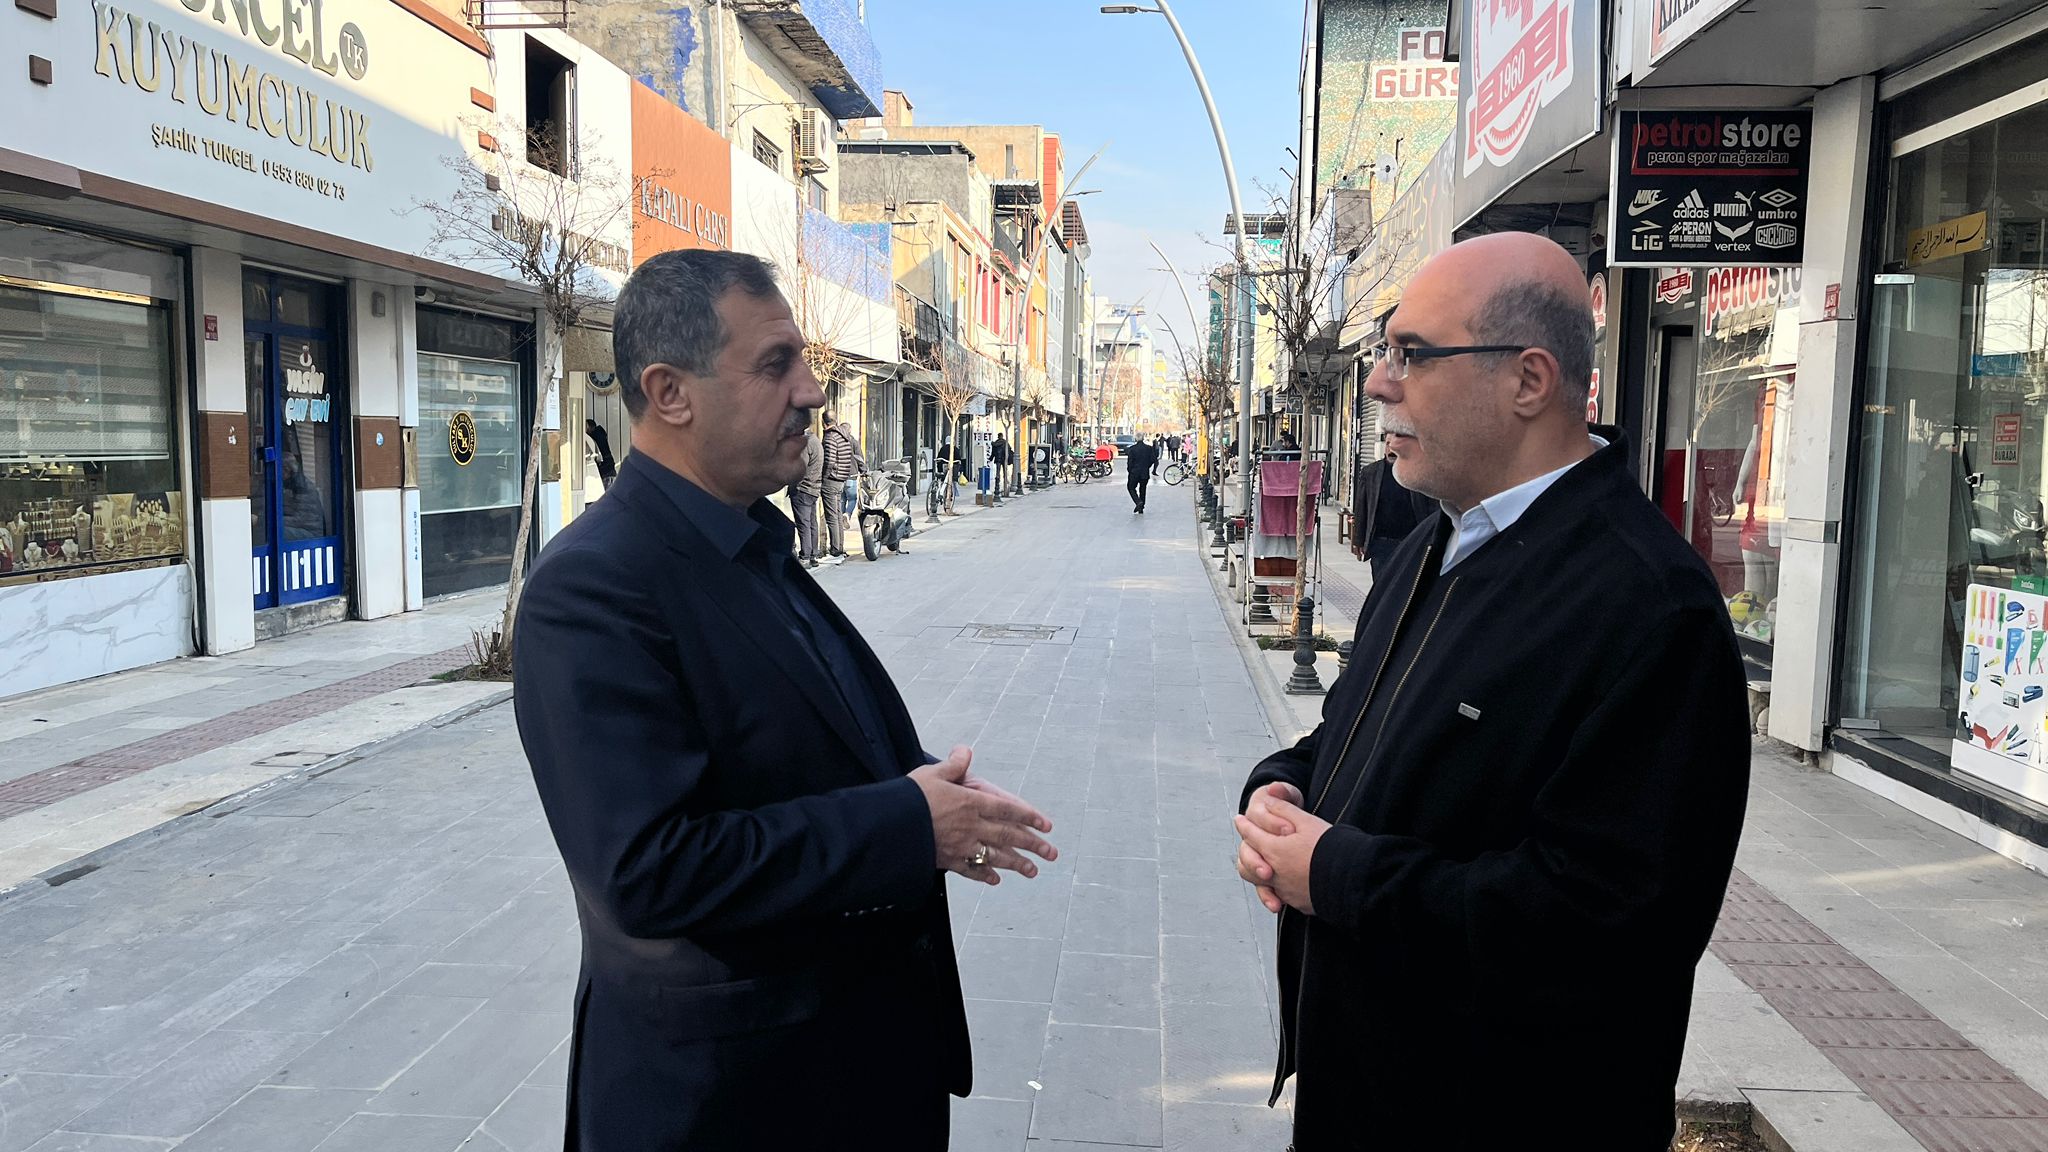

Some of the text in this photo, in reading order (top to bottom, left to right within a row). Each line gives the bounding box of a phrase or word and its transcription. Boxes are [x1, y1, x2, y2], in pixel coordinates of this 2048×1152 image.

[1498, 47, 1526, 104] 1960
[92, 0, 374, 172] KUYUMCULUK
[1632, 116, 1801, 164] petrolstore
[151, 123, 345, 201] ŞAHİN TUNCEL 0 553 860 02 73
[1648, 150, 1790, 166] peron spor mağazaları
[640, 176, 692, 233] KAPALI
[1633, 189, 1662, 205] NIKE
[1673, 207, 1709, 219] adidas
[1713, 203, 1747, 217] PUMA
[1758, 208, 1798, 220] umbro
[1682, 221, 1712, 235] PERON
[1714, 243, 1751, 252] vertex
